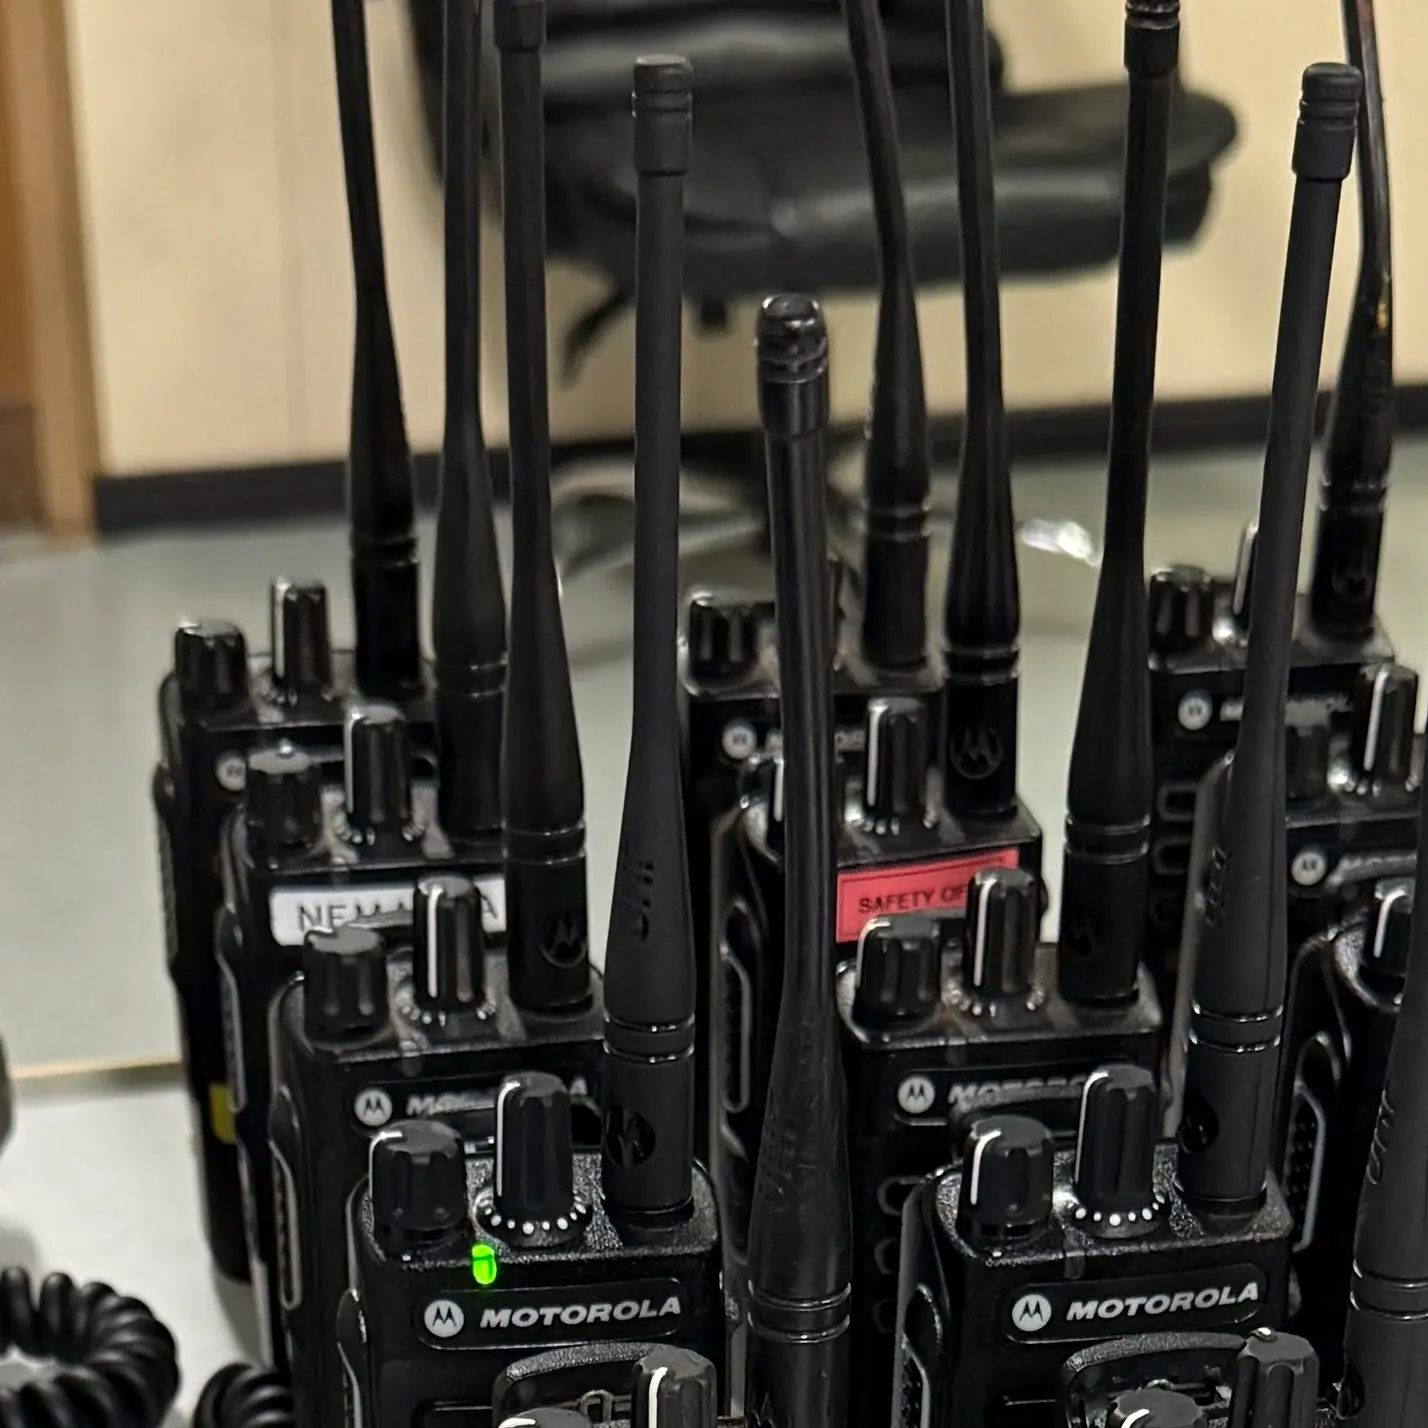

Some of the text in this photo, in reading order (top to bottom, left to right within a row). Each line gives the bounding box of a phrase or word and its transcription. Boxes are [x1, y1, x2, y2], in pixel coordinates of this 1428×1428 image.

[859, 890, 933, 914] SAFETY
[480, 1295, 683, 1329] MOTOROLA
[1066, 1282, 1259, 1321] MOTOROLA
